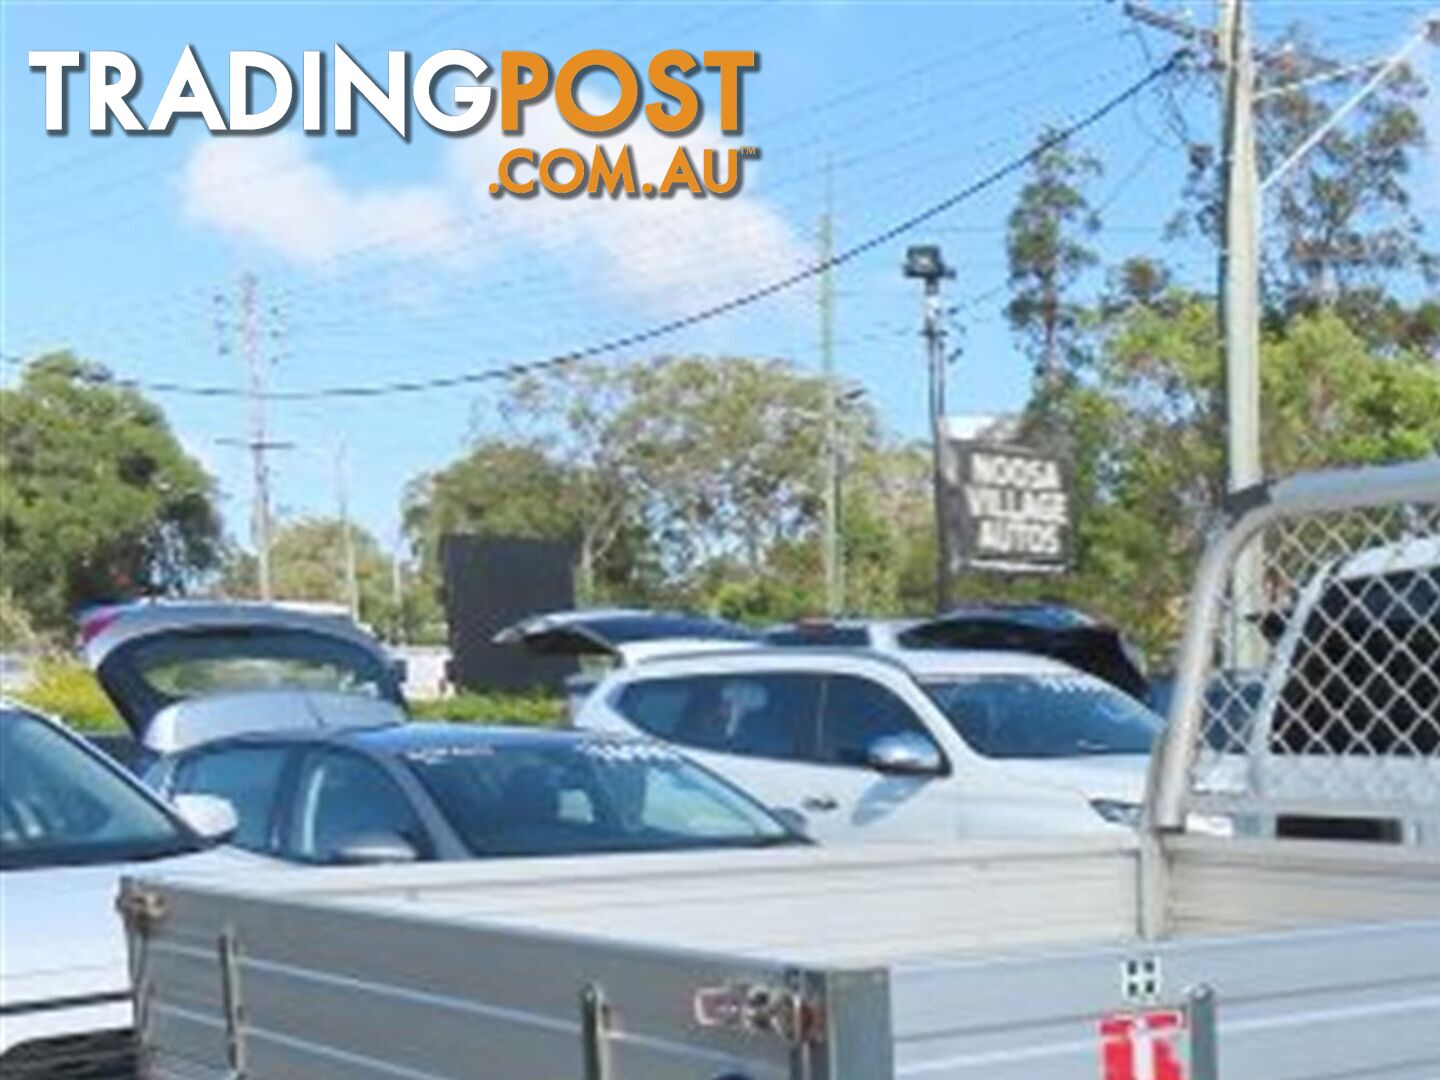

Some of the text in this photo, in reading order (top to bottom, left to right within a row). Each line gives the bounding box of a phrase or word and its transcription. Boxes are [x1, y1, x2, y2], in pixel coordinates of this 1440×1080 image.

[971, 453, 1062, 489] NOOSA
[963, 486, 1069, 524] VILLAGE
[978, 519, 1061, 554] AUTOS
